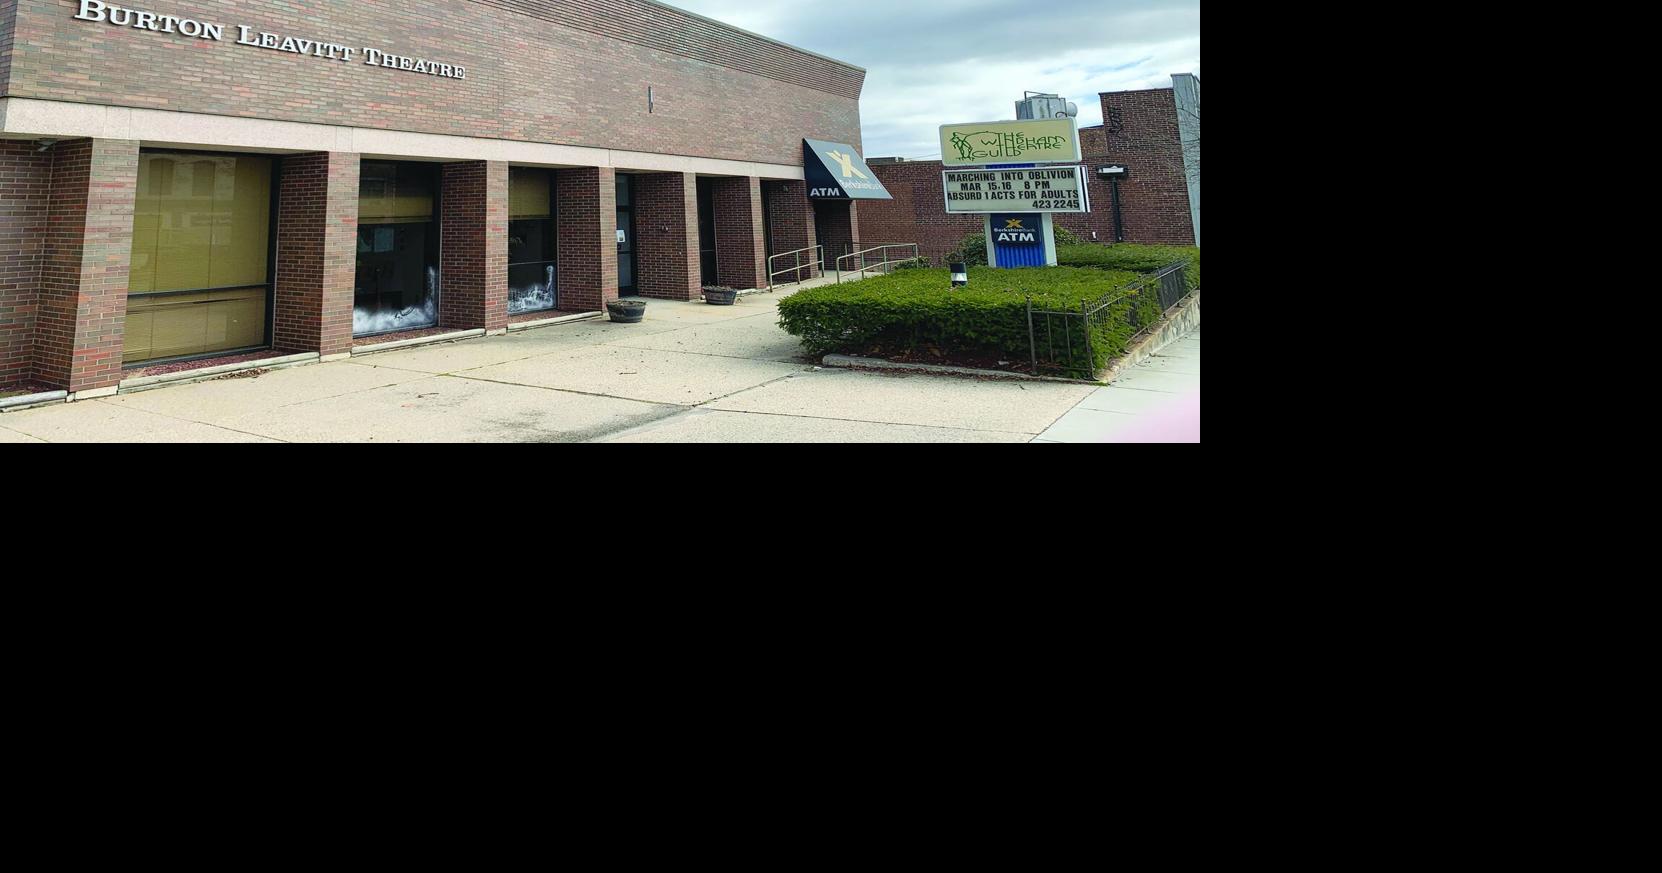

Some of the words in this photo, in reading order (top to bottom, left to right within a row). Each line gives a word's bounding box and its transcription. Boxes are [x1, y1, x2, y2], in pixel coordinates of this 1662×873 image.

[74, 0, 225, 41] BURTON
[237, 24, 354, 62] LEAVITT
[362, 47, 466, 79] THEATRE
[971, 149, 1022, 159] GUILD
[948, 173, 996, 182] MARCHING
[1001, 171, 1024, 181] INTO
[1028, 170, 1075, 180] OBLIVION
[960, 182, 982, 191] MAR
[1024, 181, 1031, 189] 8
[1035, 181, 1050, 189] PM
[810, 187, 840, 197] ATM
[948, 191, 982, 201] ABSURD
[991, 191, 1016, 200] ACTS
[1018, 190, 1037, 200] FOR
[1041, 189, 1079, 199] ADULTS
[1032, 200, 1051, 209] 423
[1053, 200, 1080, 209] 2245
[997, 232, 1035, 242] ATM
